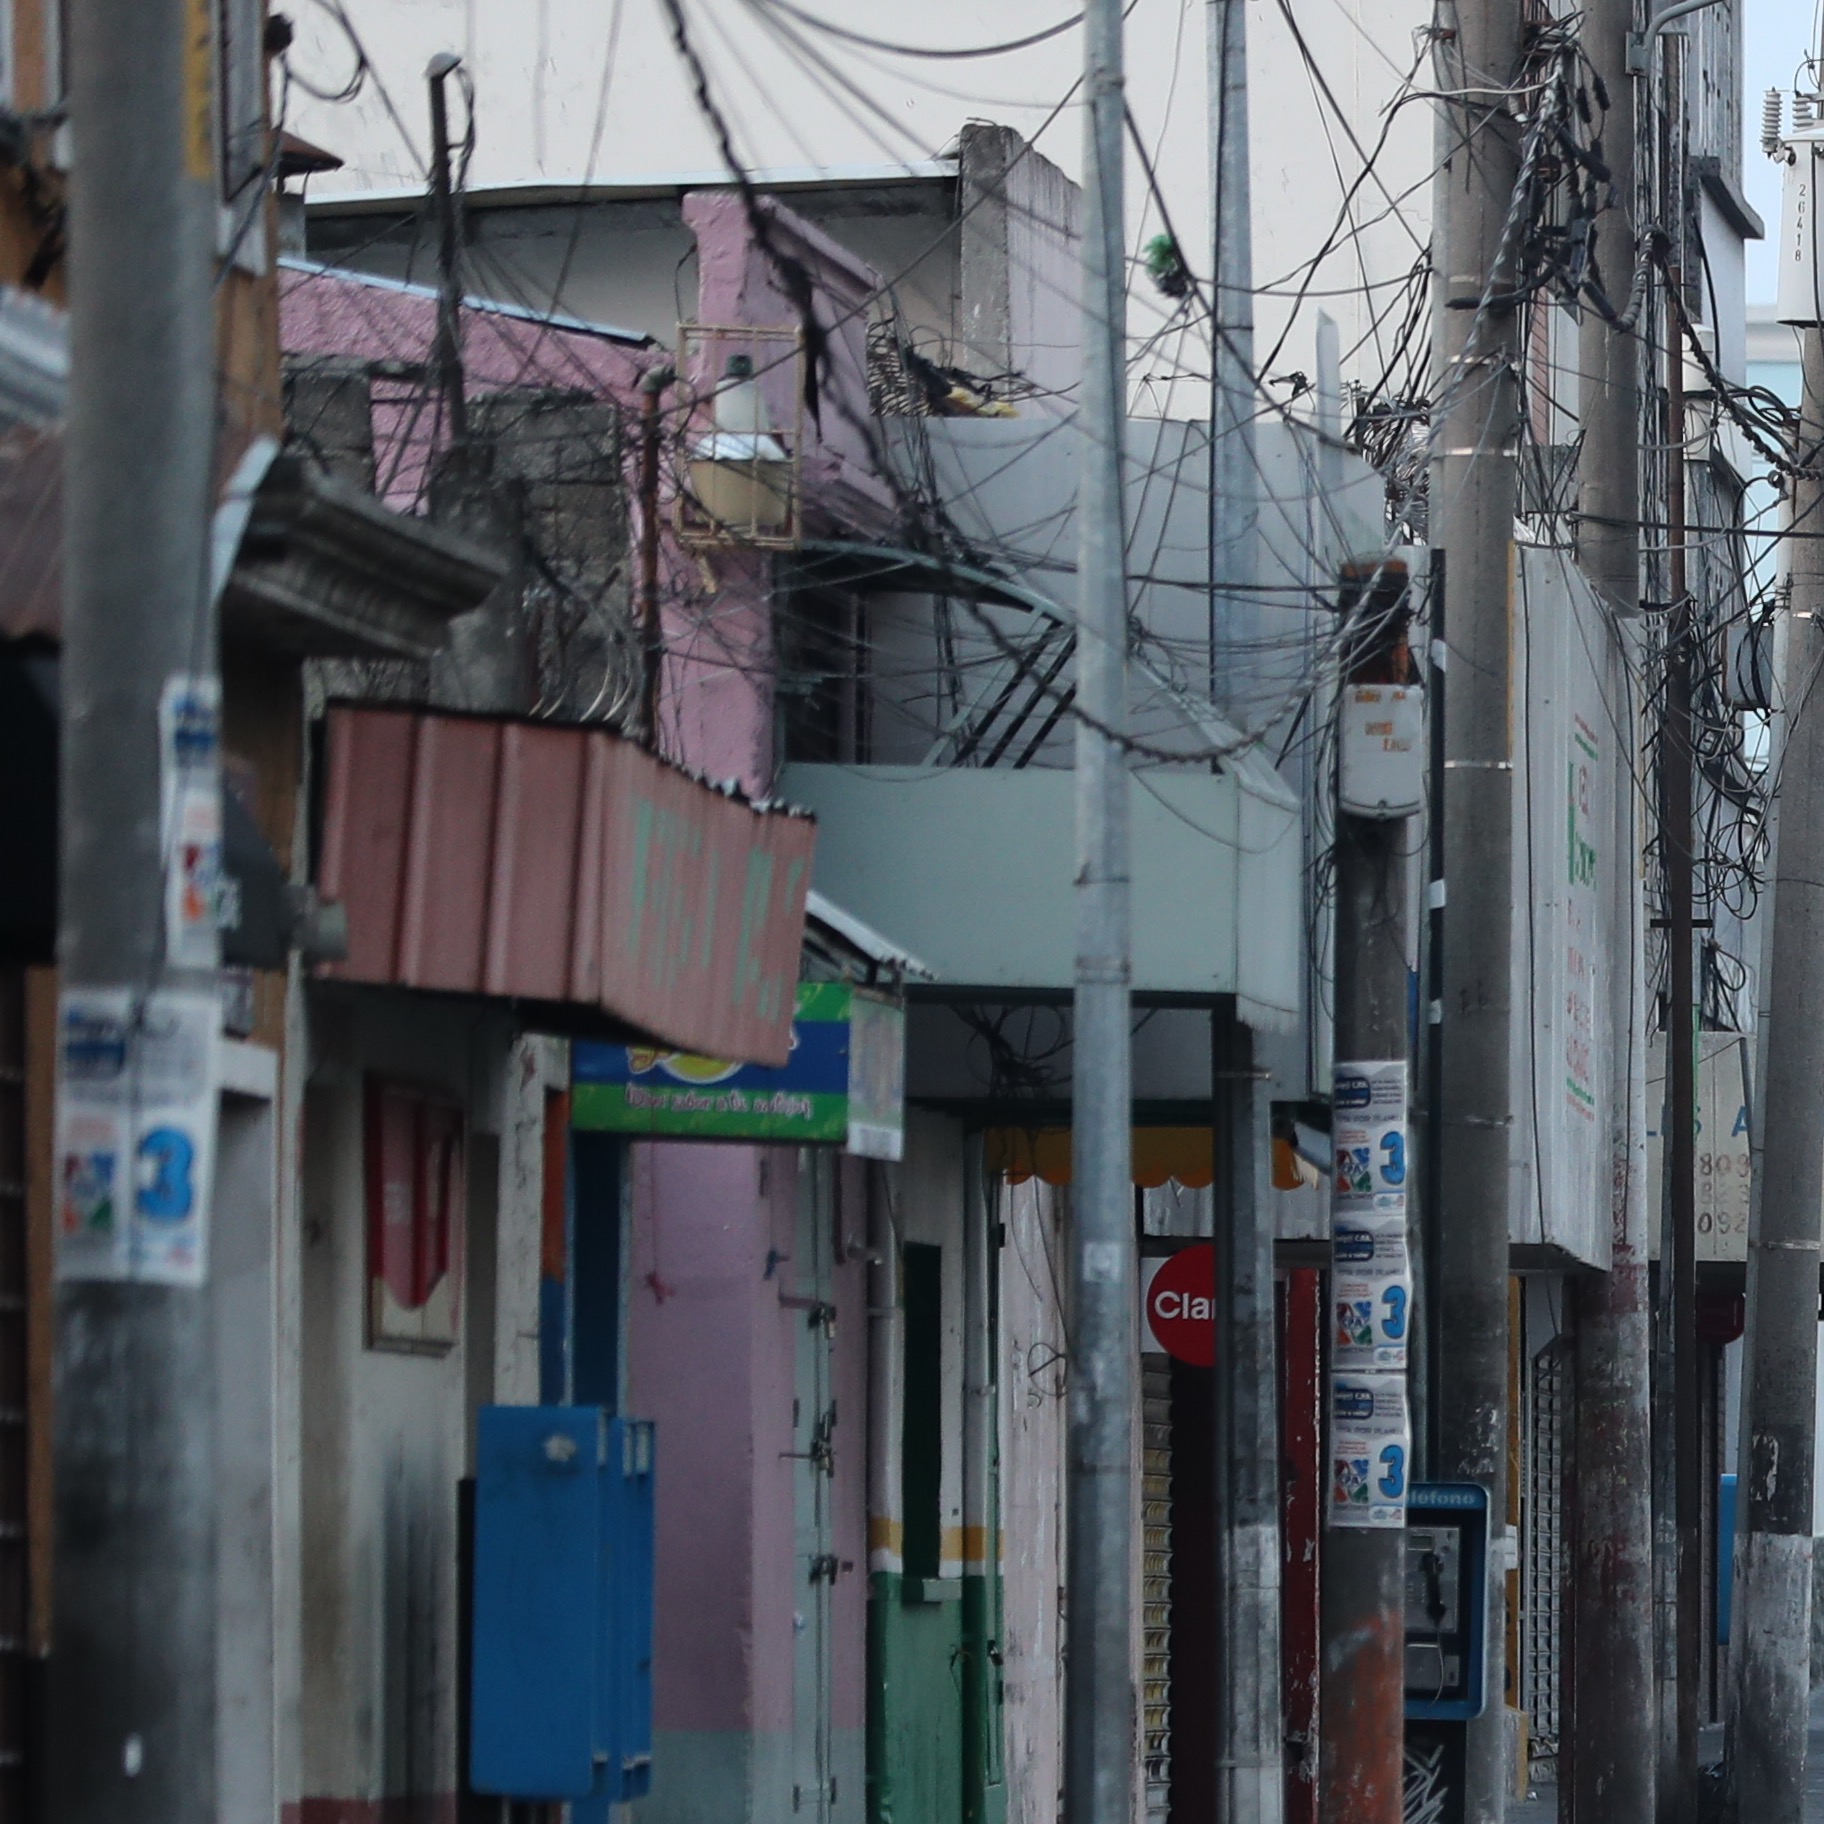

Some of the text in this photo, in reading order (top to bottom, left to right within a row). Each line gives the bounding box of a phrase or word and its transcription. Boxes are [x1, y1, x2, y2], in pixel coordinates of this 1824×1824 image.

[136, 1126, 194, 1224] 3
[1380, 1131, 1406, 1186] 3
[1154, 1290, 1215, 1320] Cla
[1381, 1285, 1406, 1339] 3
[1378, 1444, 1405, 1499] 3
[1408, 1489, 1477, 1504] léfono
